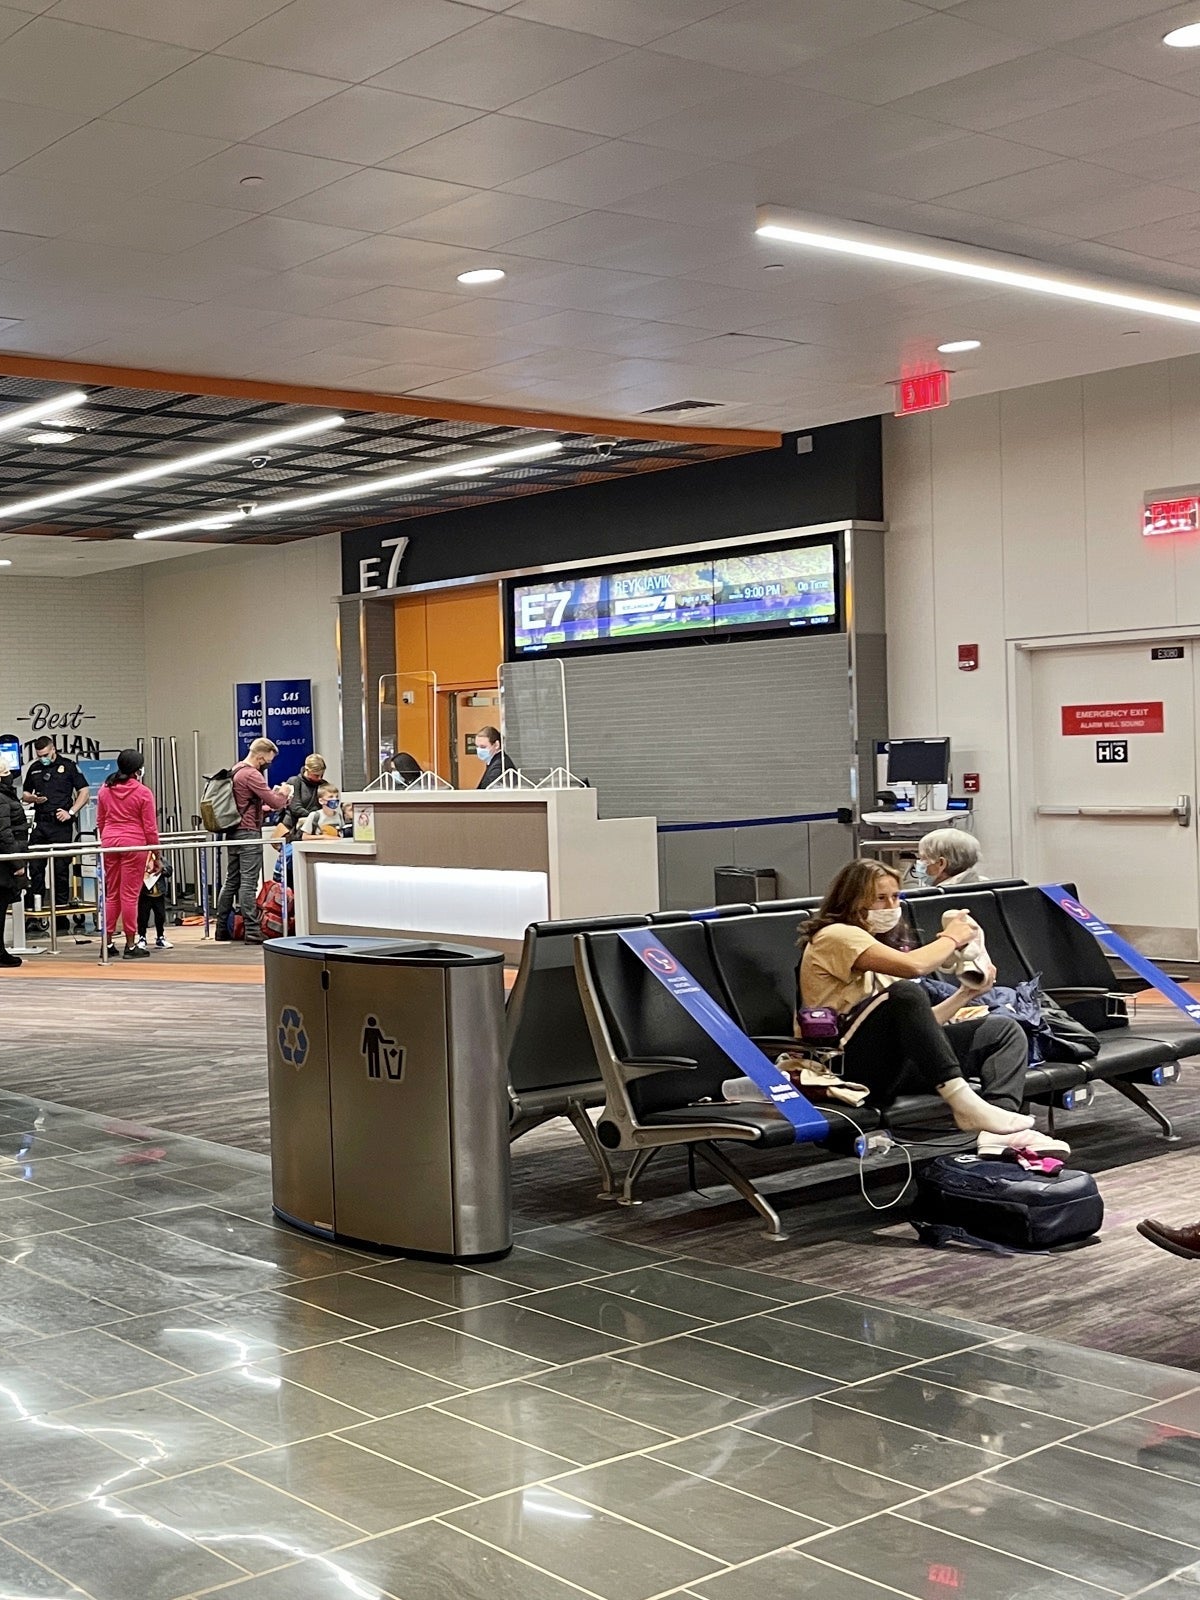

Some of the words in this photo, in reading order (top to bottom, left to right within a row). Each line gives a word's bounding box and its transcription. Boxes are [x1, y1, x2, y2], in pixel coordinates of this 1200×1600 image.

[902, 374, 942, 411] EXIT
[1151, 500, 1191, 528] EXIT
[359, 537, 409, 593] E7
[615, 575, 672, 595] REYKJAVIK
[744, 587, 764, 598] 9:00
[765, 584, 781, 596] PM
[810, 579, 829, 589] Time
[521, 591, 571, 630] E7
[281, 693, 299, 702] SAS
[29, 703, 85, 731] Best
[268, 707, 310, 716] BOARDING
[1076, 710, 1128, 719] EMERGENCY
[1129, 708, 1149, 717] EXIT
[1099, 748, 1109, 760] H
[1114, 746, 1125, 760] 3
